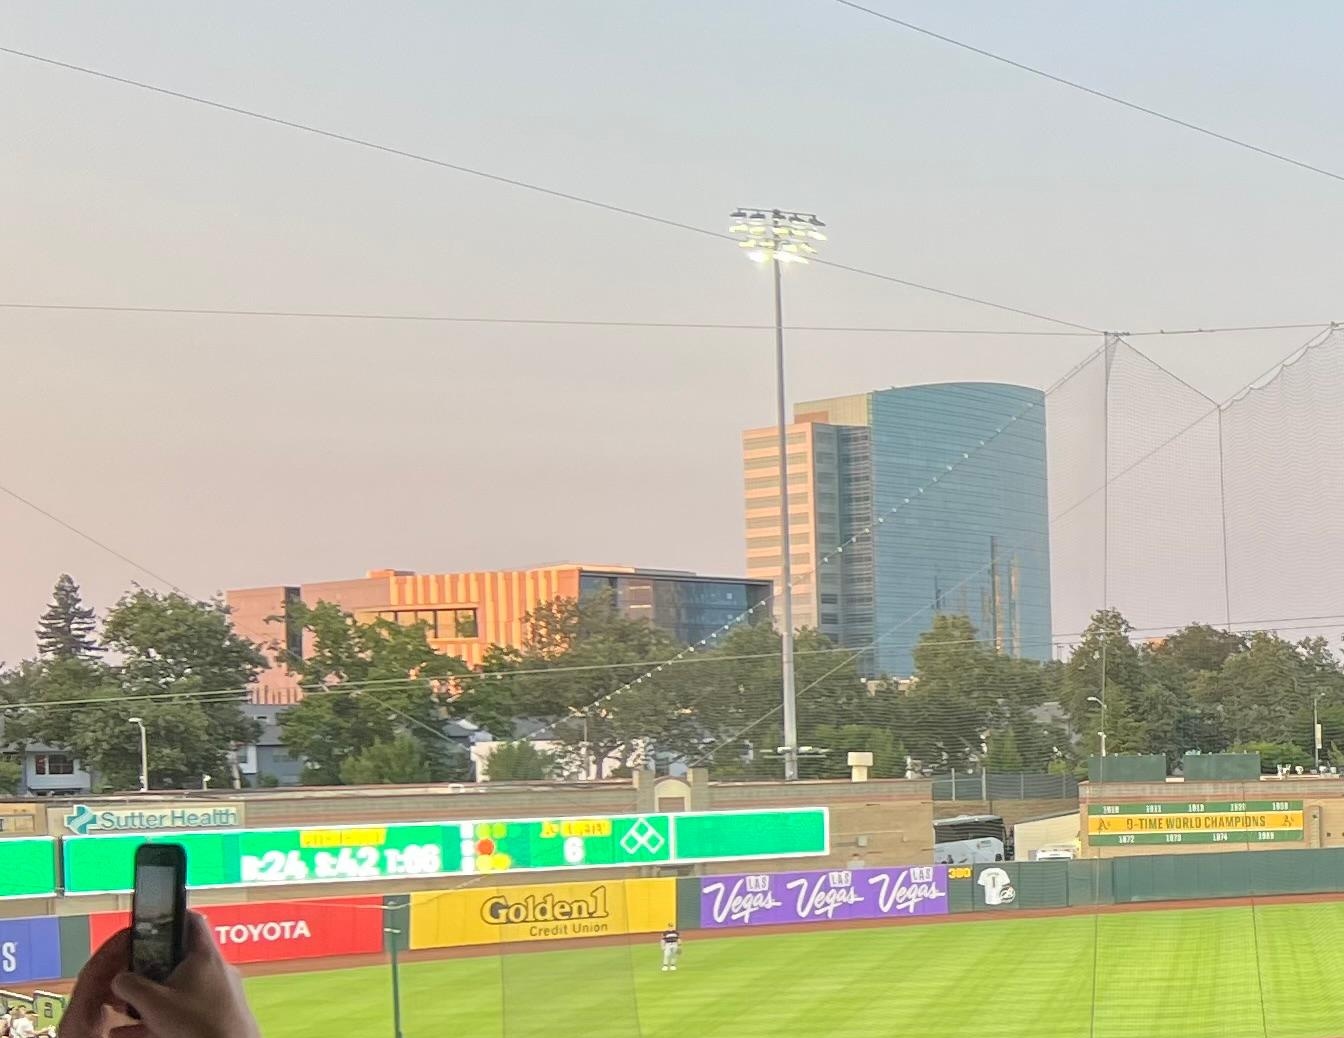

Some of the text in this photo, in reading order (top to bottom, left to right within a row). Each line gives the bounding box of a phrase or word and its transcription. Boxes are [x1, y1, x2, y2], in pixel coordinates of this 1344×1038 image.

[101, 809, 237, 828] Sutter Health
[1165, 817, 1202, 830] WORLD
[1204, 815, 1266, 829] CHAMPIONS
[829, 871, 852, 887] LAS
[910, 867, 933, 882] LAS
[745, 876, 769, 891] LAS
[868, 870, 946, 913] Vegas
[703, 878, 782, 923] Vegas
[786, 875, 864, 918] Vegas
[215, 920, 312, 945] TOYOTA
[529, 922, 608, 938] Credit Union
